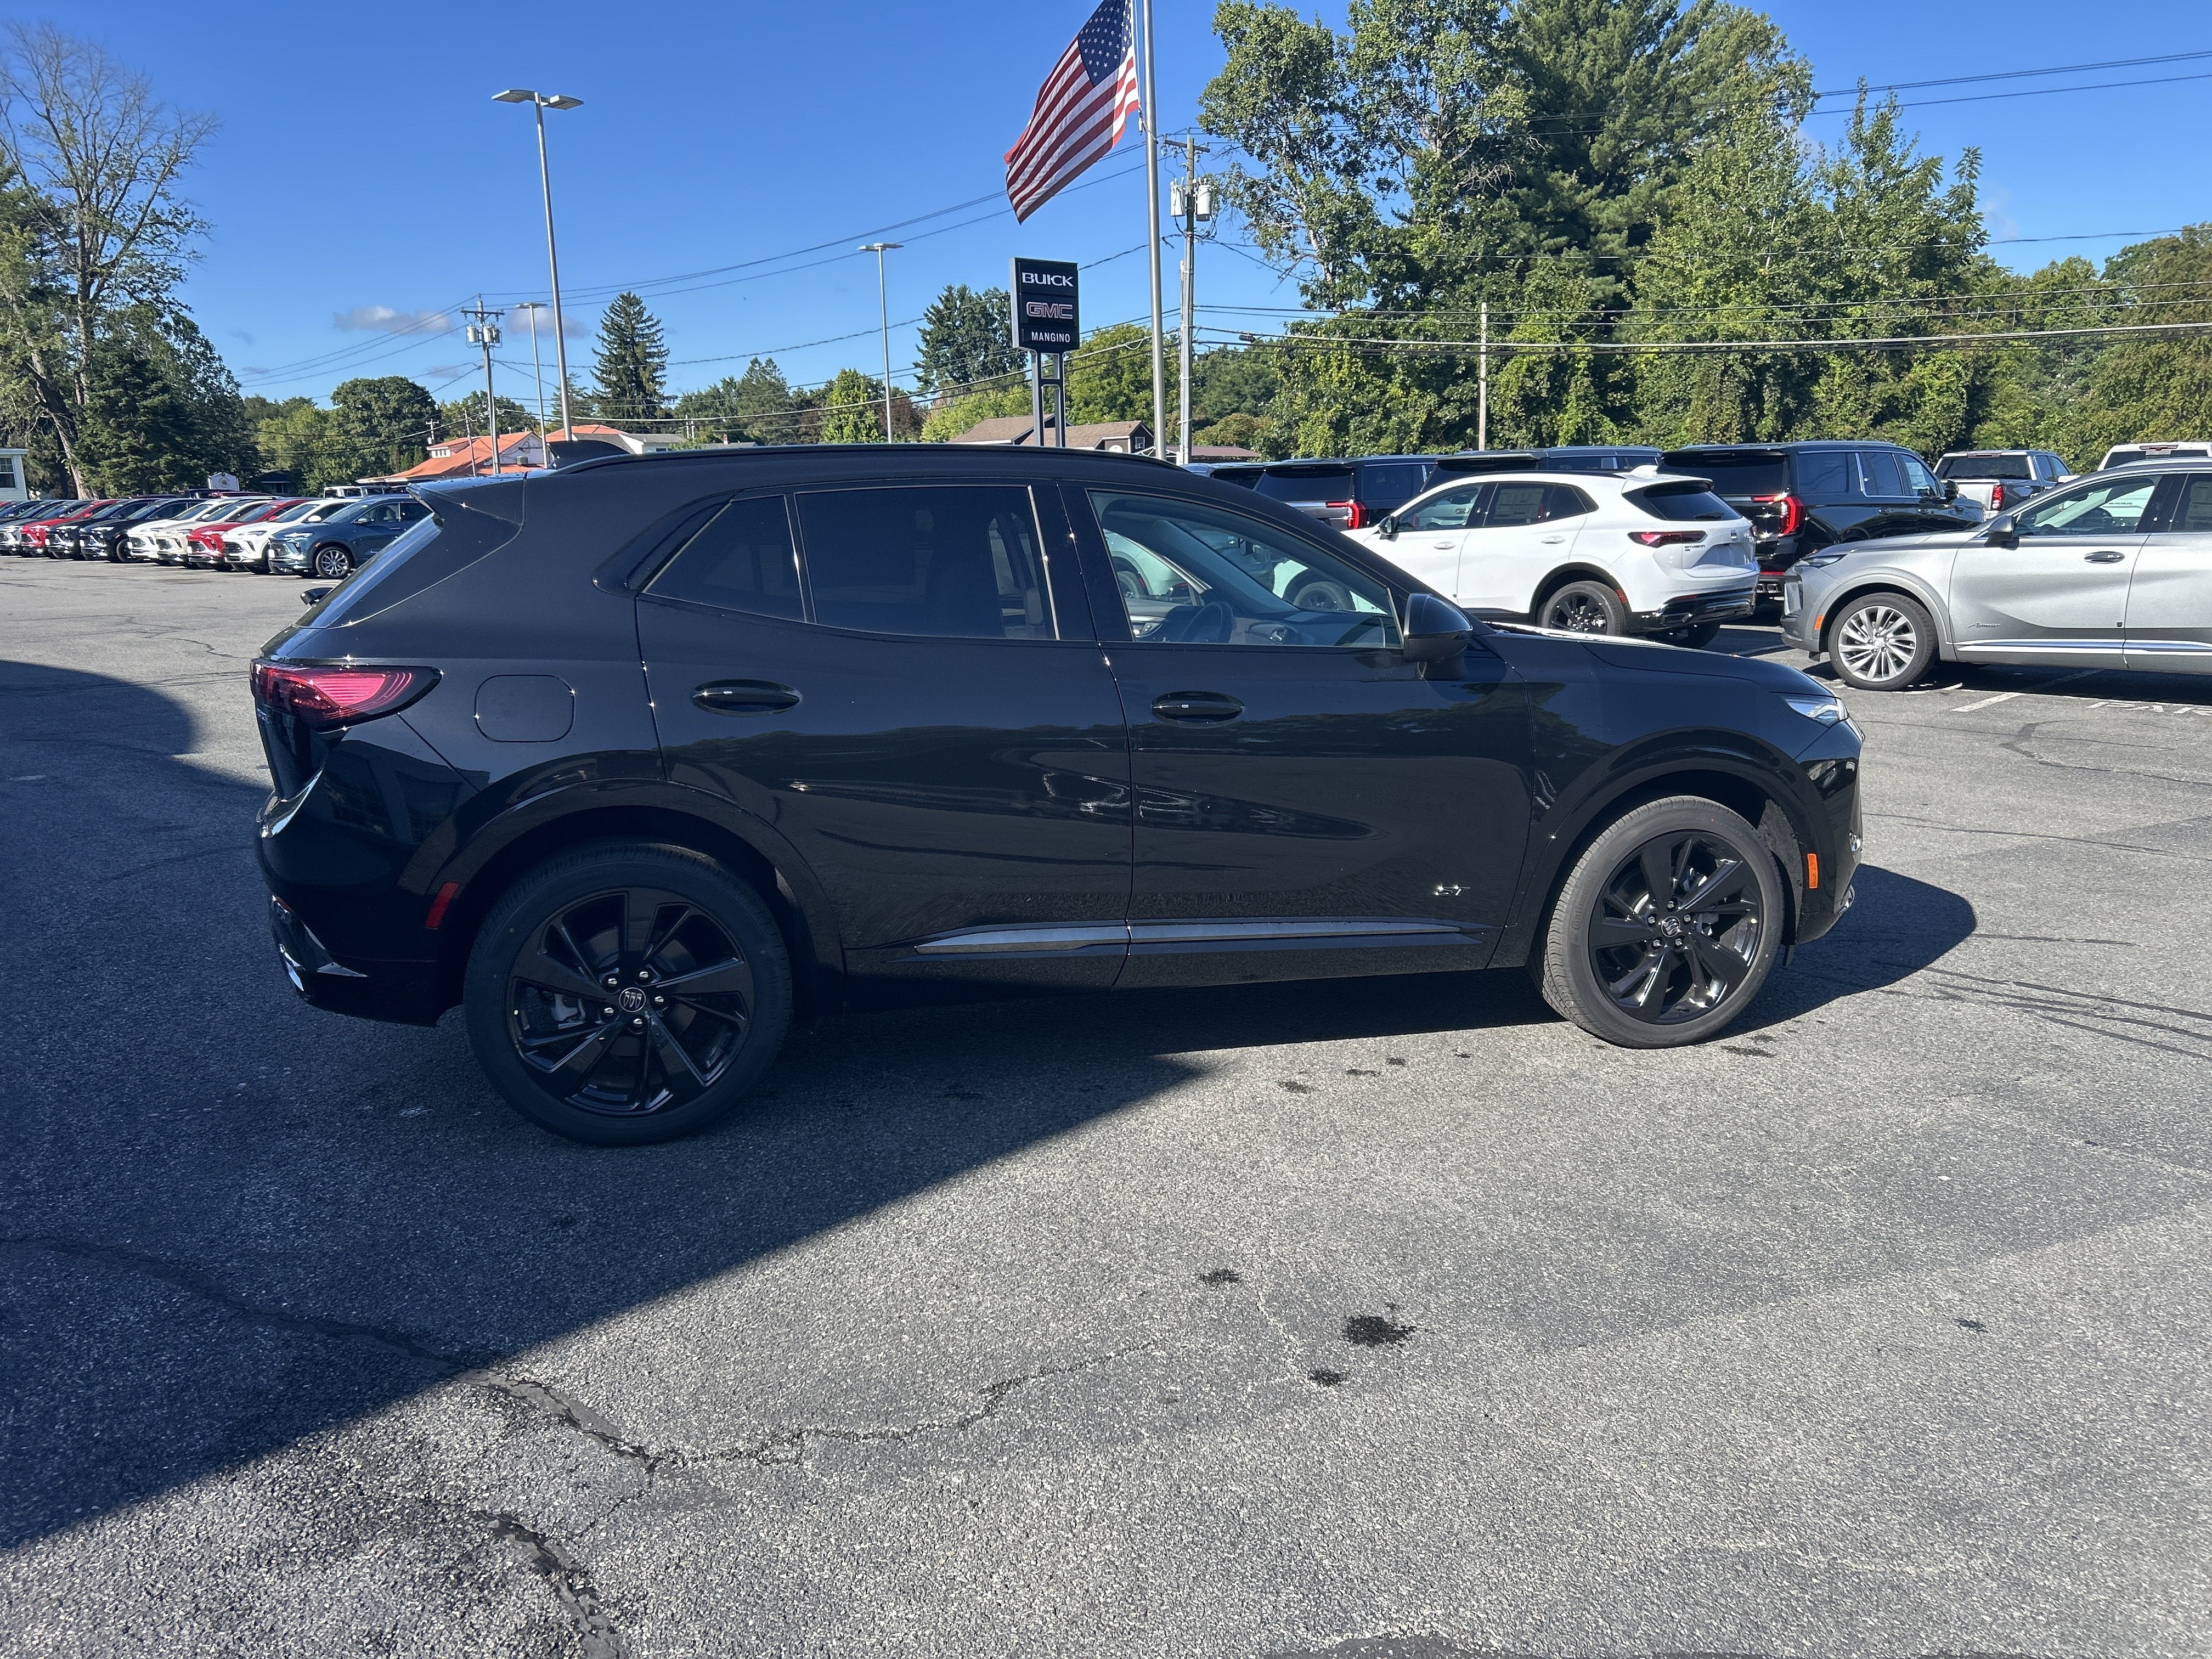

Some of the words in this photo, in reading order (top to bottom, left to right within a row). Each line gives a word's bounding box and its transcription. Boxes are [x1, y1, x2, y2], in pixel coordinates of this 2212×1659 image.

[1022, 272, 1074, 287] BUICK
[1026, 301, 1073, 319] GMC
[1031, 331, 1070, 343] MANGINO
